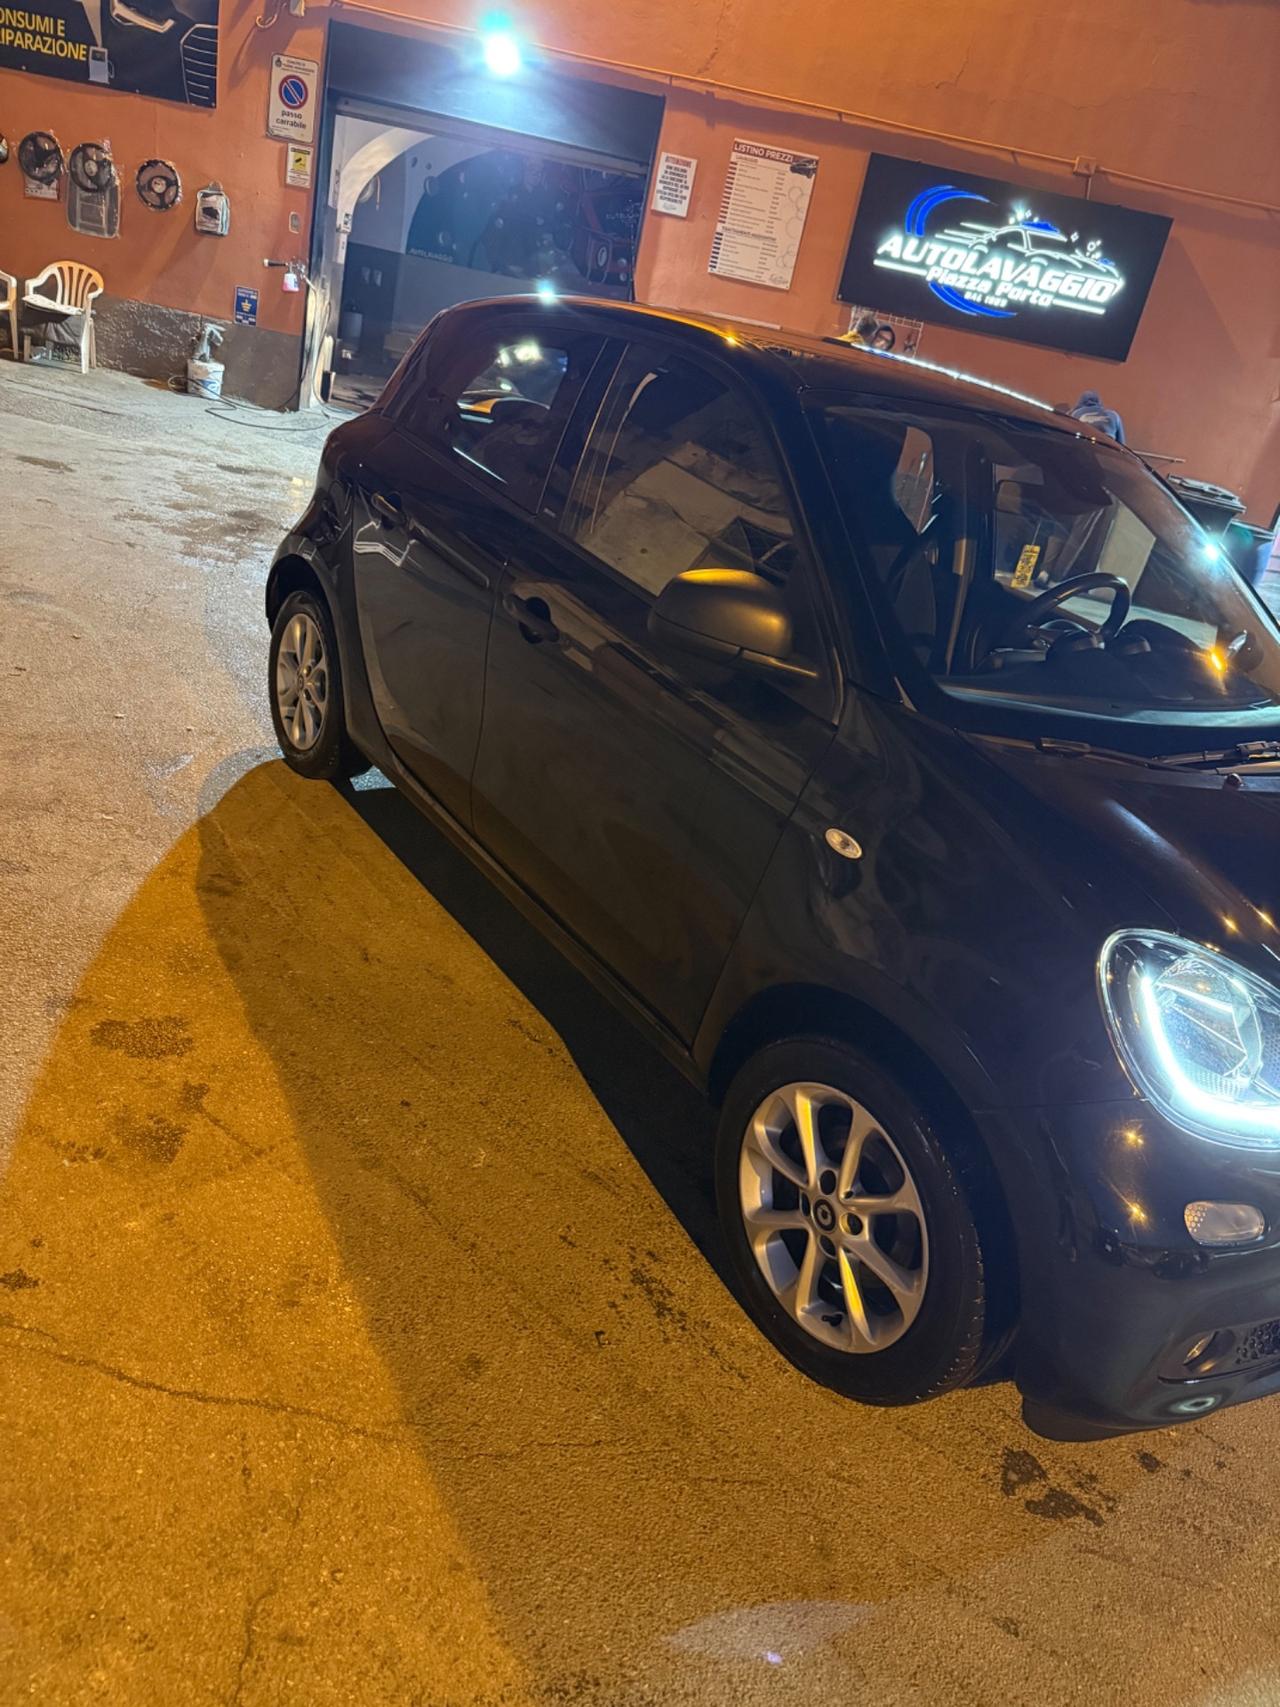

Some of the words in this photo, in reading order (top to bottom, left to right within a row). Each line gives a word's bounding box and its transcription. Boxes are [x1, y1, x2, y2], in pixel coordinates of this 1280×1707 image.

[56, 18, 65, 37] E
[0, 27, 87, 61] IPARAZIONE
[275, 118, 307, 130] carrabile
[281, 110, 303, 120] passo
[733, 142, 764, 157] LISTINO
[765, 149, 794, 163] PREZZI
[876, 234, 1118, 303] AUTOLAVAGGIO
[995, 280, 1054, 307] Porto
